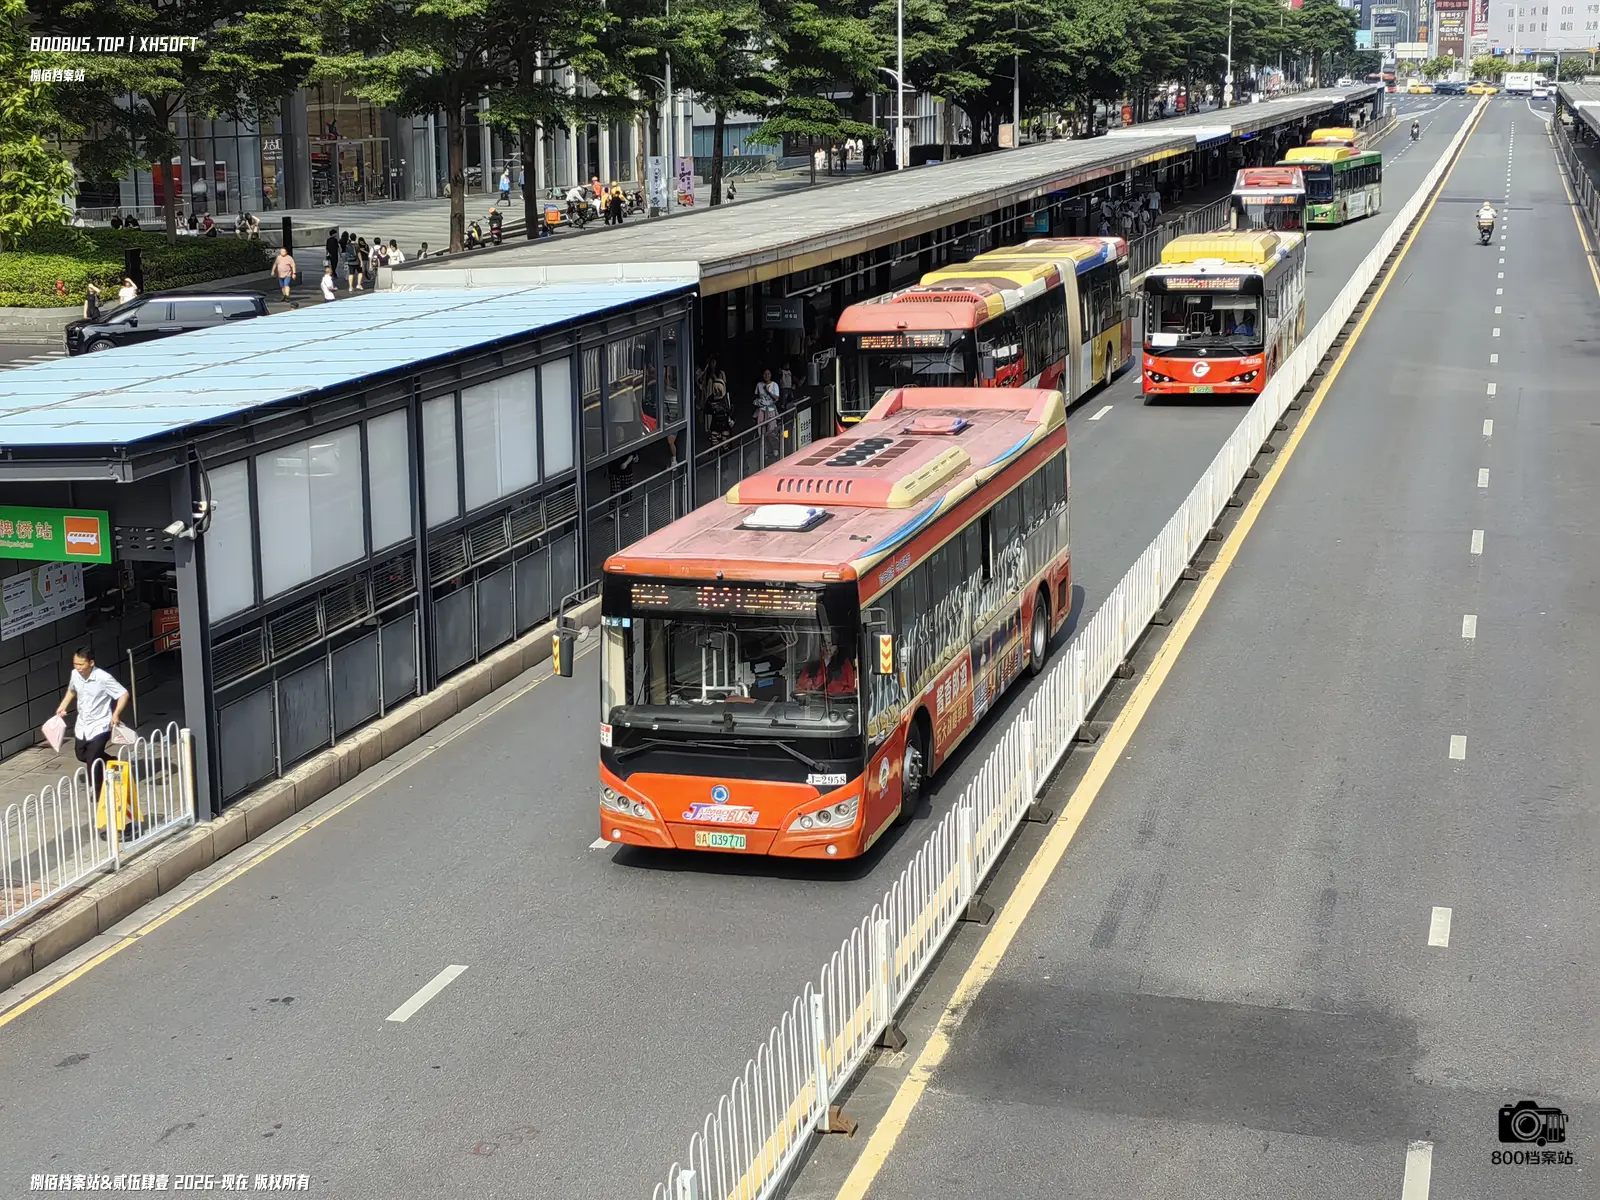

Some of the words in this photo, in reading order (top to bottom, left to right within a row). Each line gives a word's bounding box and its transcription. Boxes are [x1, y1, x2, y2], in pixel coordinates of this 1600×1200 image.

[1561, 6, 1574, 15] 自由
[0, 519, 53, 541] 牌桥站
